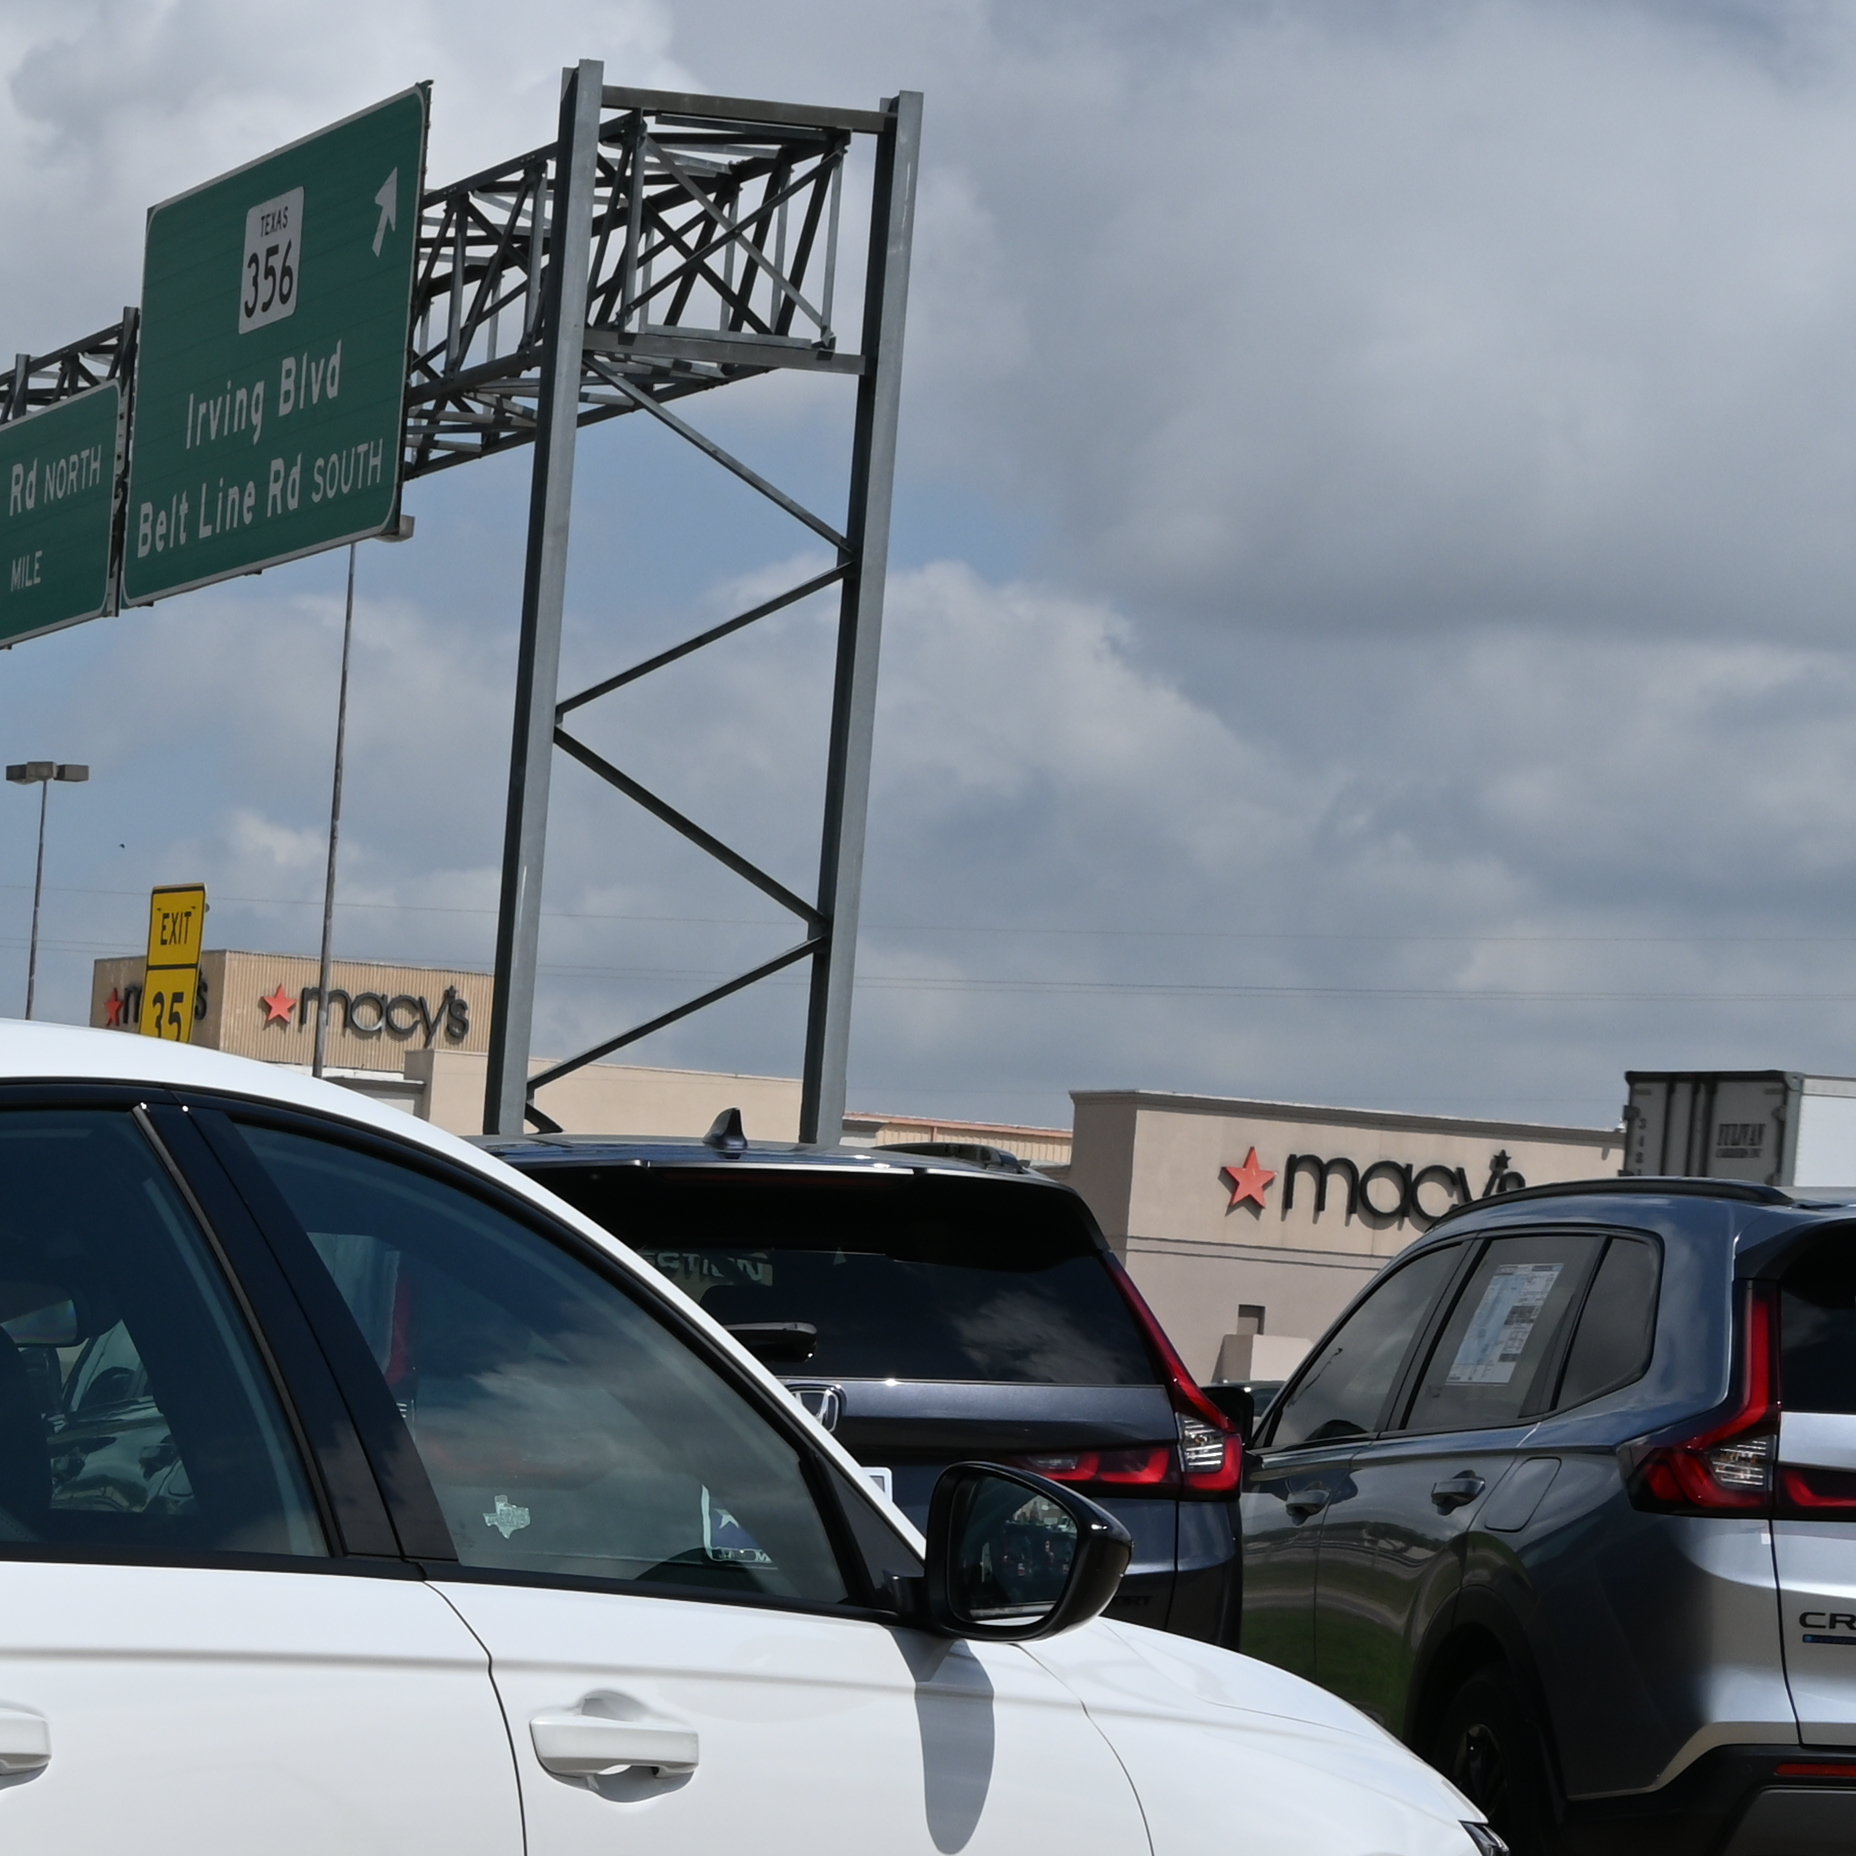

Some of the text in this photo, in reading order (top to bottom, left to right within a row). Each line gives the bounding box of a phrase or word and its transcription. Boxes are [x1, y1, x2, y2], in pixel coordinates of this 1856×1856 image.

[260, 204, 288, 238] TEXAS
[244, 241, 293, 319] 356
[185, 338, 342, 450] Irving Blvd
[9, 457, 37, 516] Rd
[44, 444, 102, 504] NORTH
[137, 437, 384, 559] Belt Line Rd SOUTH
[10, 550, 43, 592] MILE
[160, 911, 192, 946] EXIT
[300, 984, 469, 1048] macy's
